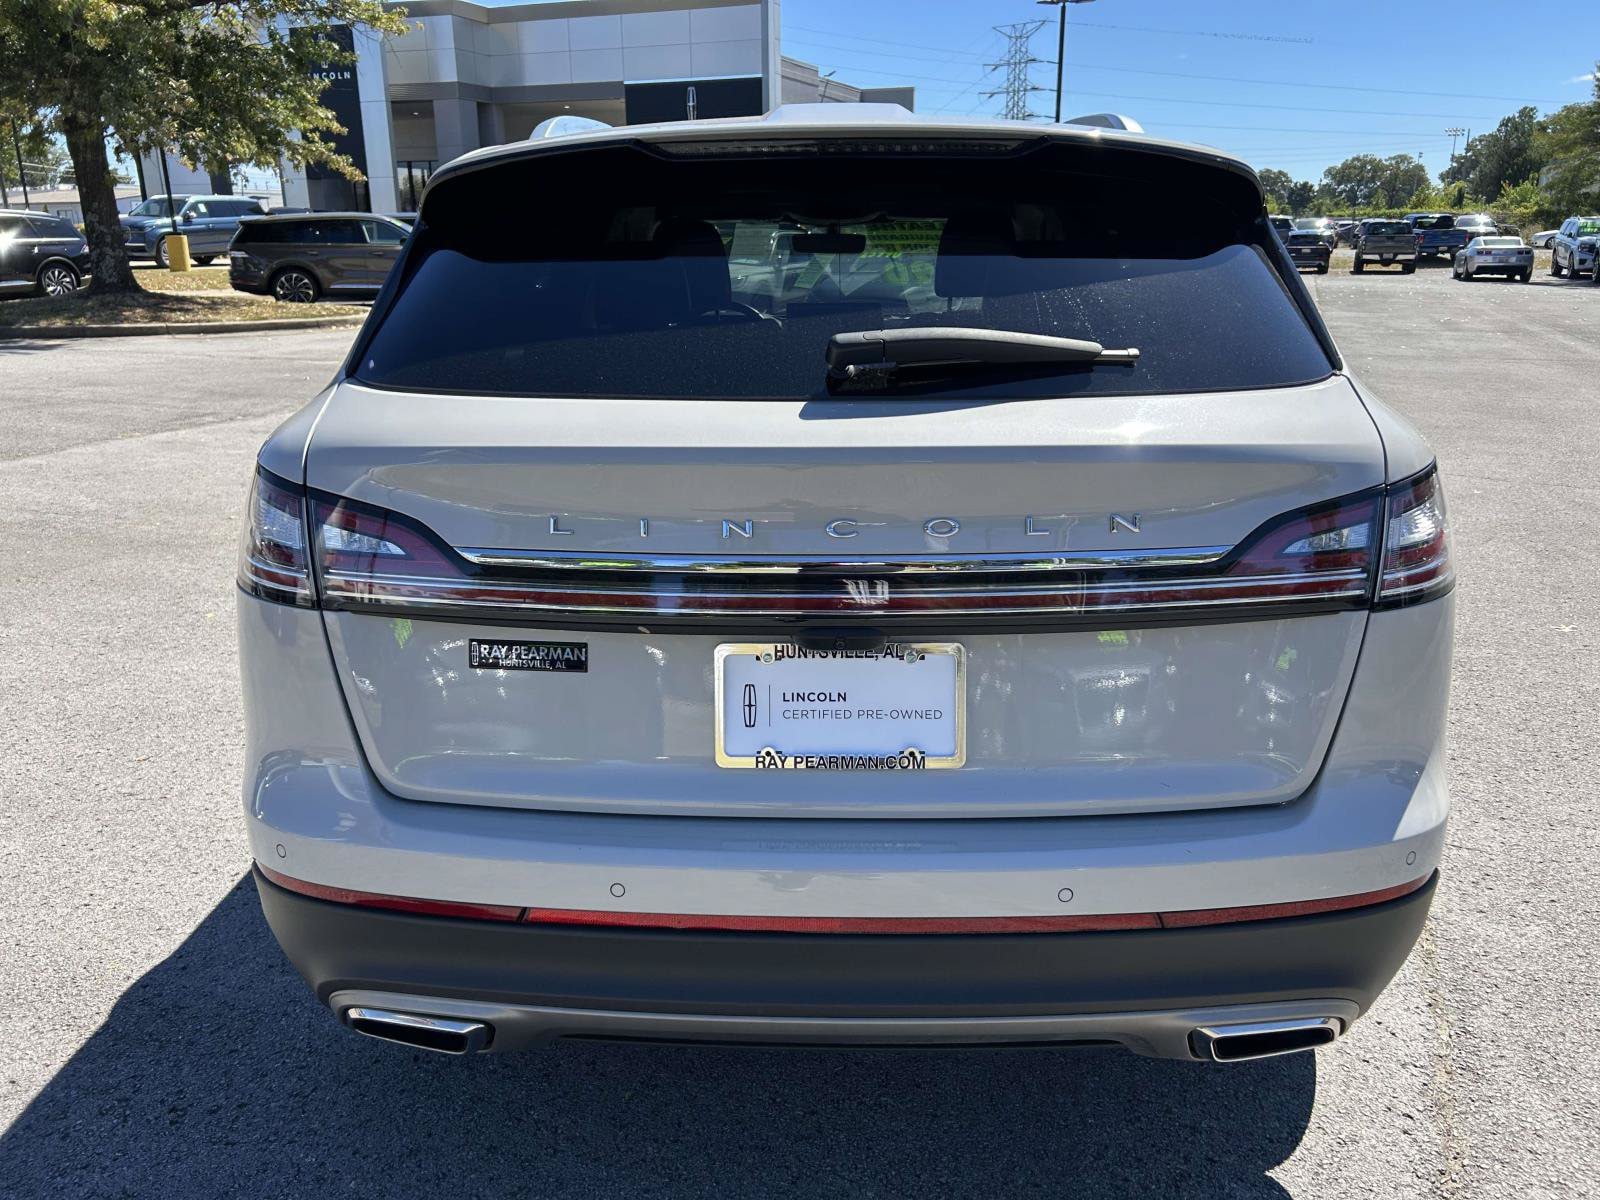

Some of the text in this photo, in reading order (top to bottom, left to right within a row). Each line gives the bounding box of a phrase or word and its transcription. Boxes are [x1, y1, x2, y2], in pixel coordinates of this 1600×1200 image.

[306, 71, 351, 80] NCOLN
[549, 513, 1141, 539] LINCOLN
[481, 644, 586, 662] RAY PEARMAN
[882, 644, 905, 660] AL
[555, 661, 567, 669] AL
[782, 692, 847, 703] LINCOLN
[782, 709, 943, 720] CERTIFIED PRE-OWNED
[755, 755, 926, 769] RAY PEARMAN.COM
